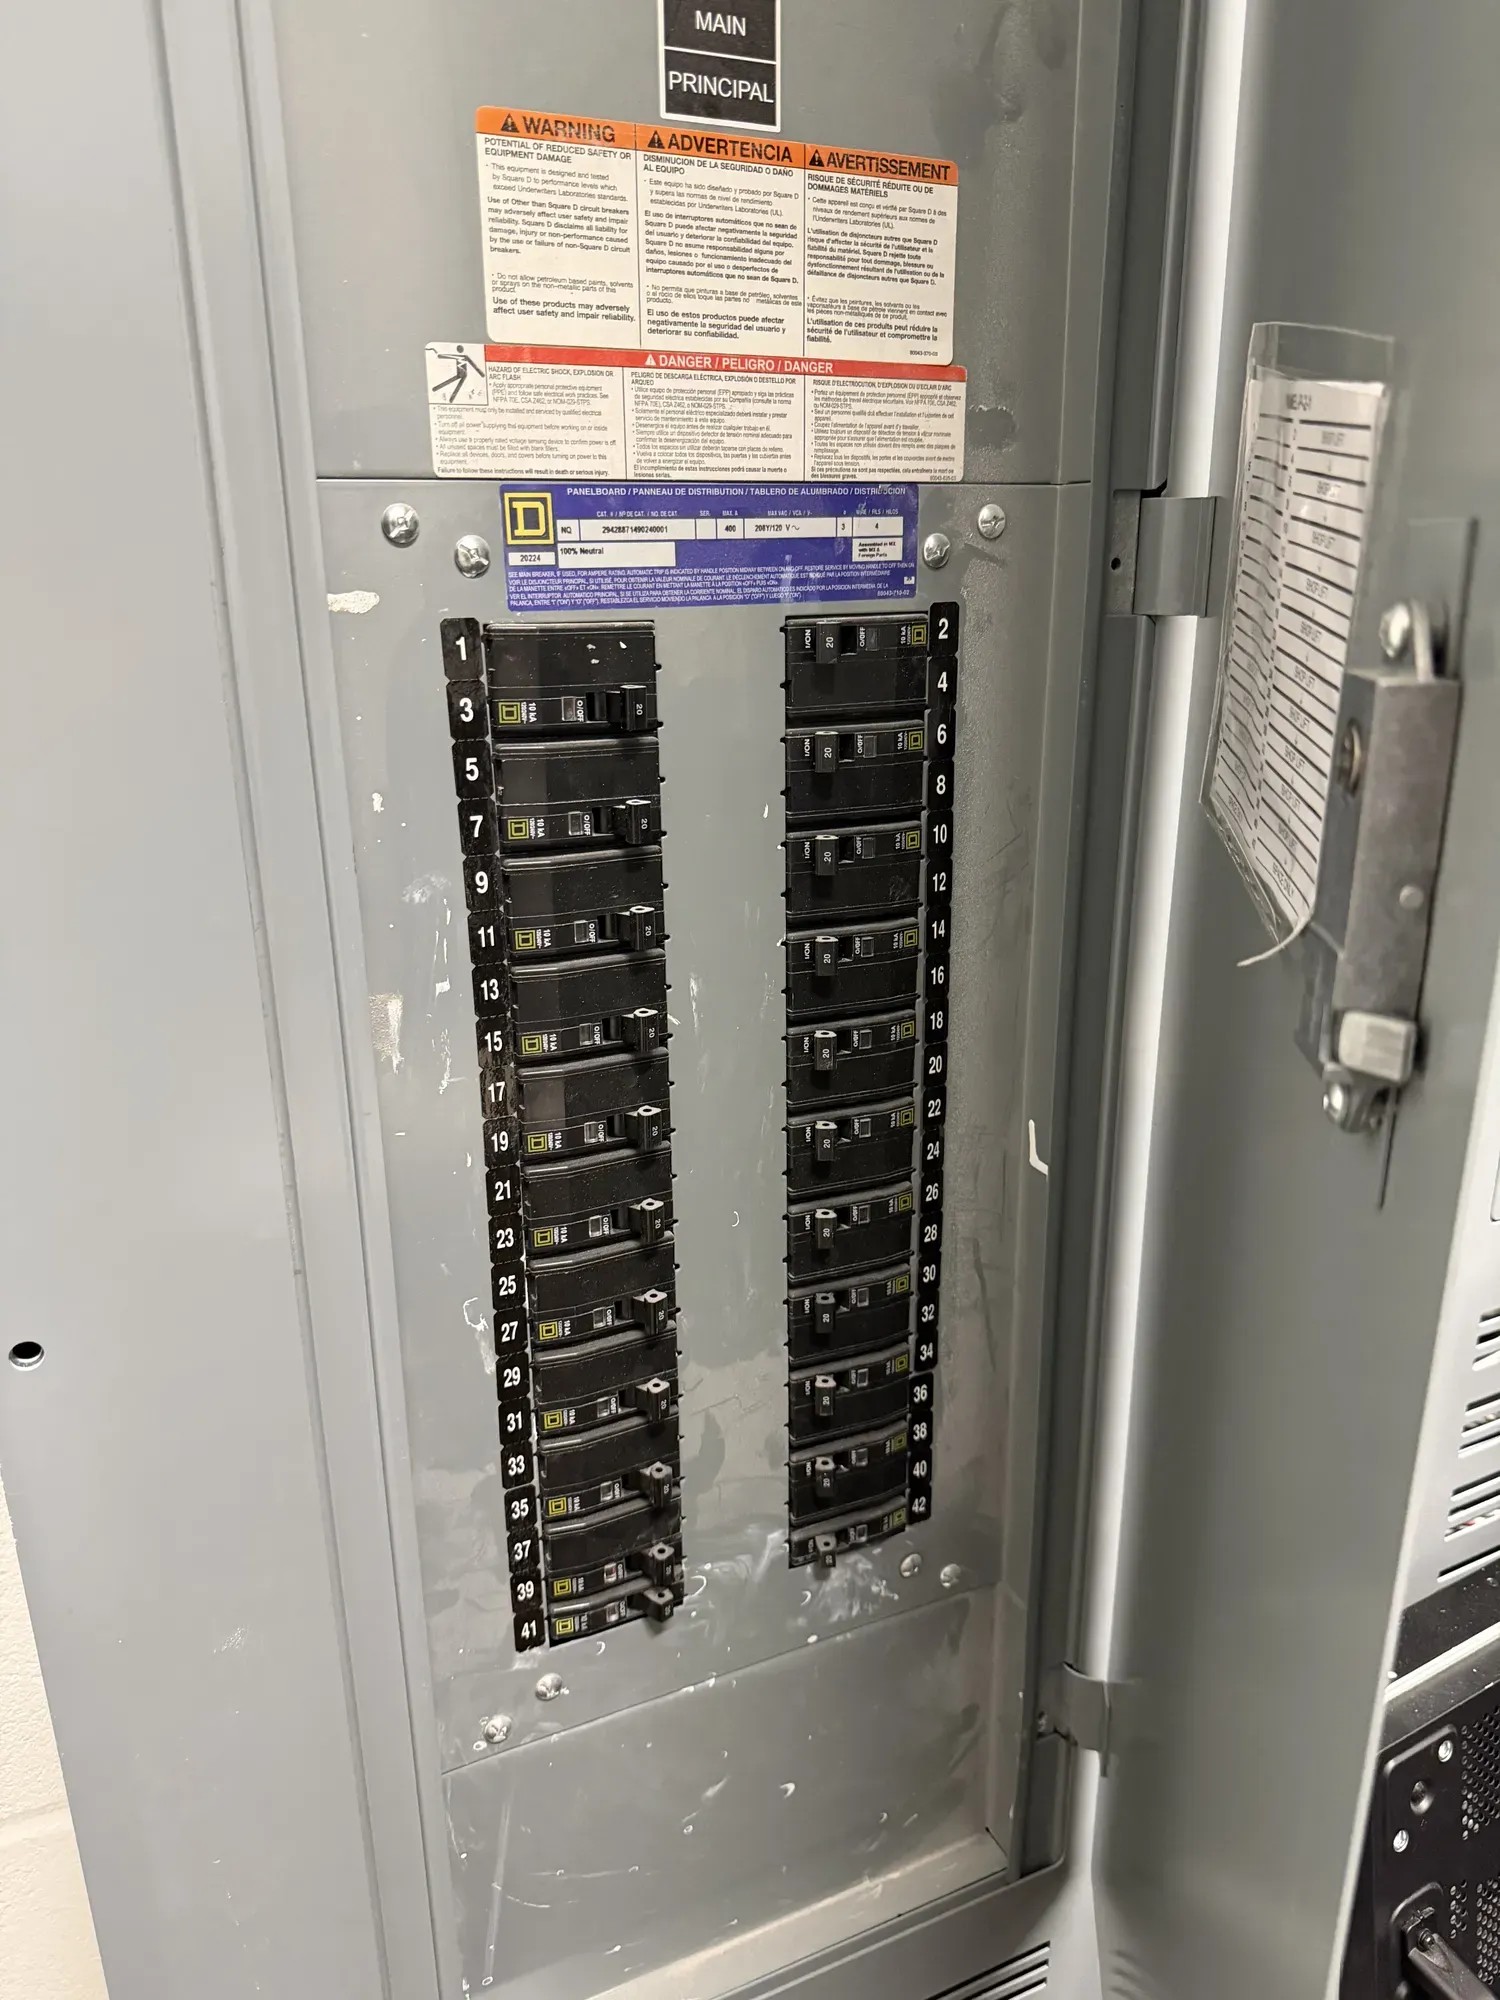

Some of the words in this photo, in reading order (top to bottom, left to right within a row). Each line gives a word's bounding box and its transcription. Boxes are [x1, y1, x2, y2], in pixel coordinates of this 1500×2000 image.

[695, 10, 746, 36] MAIN
[668, 71, 774, 103] PRINCIPAL
[522, 116, 615, 142] WARNING
[484, 137, 530, 150] POTENTIAL
[533, 142, 543, 150] OF
[546, 144, 586, 155] REDUCED
[587, 148, 617, 159] SAFETY
[620, 151, 631, 160] OR
[485, 148, 534, 159] EQUIPMENT
[537, 153, 572, 163] DAMAGE
[668, 134, 793, 163] ADVERTENCIA
[644, 154, 695, 167] DISMINUCION
[709, 161, 719, 169] LA
[720, 163, 763, 174] SEGURIDAD
[773, 167, 793, 177] DAÑO
[644, 164, 653, 172] AL
[656, 166, 685, 176] EQUIPO
[827, 152, 950, 181] AVERTISSEMENT
[808, 174, 833, 183] RISQUE
[847, 177, 880, 188] SÉCURITÉ
[882, 181, 911, 192] RÉDUITE
[913, 185, 922, 193] OU
[924, 186, 933, 194] DE
[808, 183, 848, 194] DOMMAGES
[851, 186, 888, 198] MATÉRIELS
[493, 306, 515, 315] affect
[536, 309, 558, 318] safety
[577, 312, 599, 320] impair
[602, 313, 635, 322] reliability.
[520, 299, 540, 307] these
[543, 301, 575, 310] products
[578, 303, 593, 311] may
[596, 304, 630, 313] adversely
[647, 318, 698, 328] negativamente
[709, 322, 741, 332] seguridad
[744, 323, 754, 331] del
[756, 325, 780, 333] usuario
[671, 310, 679, 318] de
[703, 313, 737, 323] productos
[739, 315, 759, 324] puede
[761, 316, 784, 324] afectar
[807, 318, 843, 327] L'utilisation
[867, 322, 892, 332] produits
[895, 324, 908, 333] peut
[910, 323, 930, 332] réduire
[647, 328, 681, 336] deteriorar
[694, 330, 739, 339] confiabilidad.
[807, 326, 832, 335] sécurité
[888, 332, 930, 342] compromettre
[807, 335, 832, 343] fiabilité.
[659, 354, 711, 368] DANGER
[722, 358, 774, 371] PELIGRO
[785, 361, 833, 374] DANGER
[725, 524, 736, 532] 400
[754, 524, 783, 532] 208Y/120
[841, 523, 845, 531] 3
[580, 547, 604, 555] Neutral
[938, 617, 949, 640] 2
[455, 636, 467, 661] 1
[826, 636, 834, 648] 20
[937, 671, 948, 693] 4
[458, 697, 474, 723] 3
[529, 702, 536, 711] 10
[636, 703, 643, 715] 20
[937, 723, 947, 745] 6
[824, 747, 832, 759] 20
[465, 757, 480, 782] 5
[936, 774, 946, 795] 8
[469, 814, 484, 838] 7
[641, 818, 648, 830] 20
[932, 823, 948, 844] 10
[824, 851, 831, 863] 20
[474, 870, 489, 894] 9
[932, 871, 947, 892] 12
[477, 925, 495, 948] 11
[645, 925, 651, 937] 20
[931, 919, 945, 939] 14
[824, 953, 831, 964] 20
[930, 965, 945, 985] 16
[480, 978, 500, 1001] 13
[930, 1010, 944, 1030] 18
[484, 1030, 503, 1053] 15
[649, 1028, 654, 1039] 20
[822, 1049, 830, 1059] 20
[928, 1055, 943, 1075] 20
[487, 1080, 506, 1103] 17
[927, 1098, 941, 1118] 22
[652, 1125, 658, 1137] 20
[490, 1130, 509, 1153] 19
[824, 1139, 831, 1149] 20
[926, 1141, 940, 1160] 24
[494, 1179, 511, 1202] 21
[925, 1182, 939, 1202] 26
[655, 1218, 660, 1229] 20
[923, 1224, 938, 1243] 28
[496, 1227, 515, 1250] 23
[922, 1264, 936, 1283] 30
[498, 1274, 517, 1297] 25
[921, 1303, 935, 1323] 32
[500, 1320, 519, 1343] 27
[919, 1342, 933, 1361] 34
[503, 1366, 521, 1388] 29
[913, 1384, 928, 1403] 36
[506, 1410, 523, 1433] 31
[913, 1422, 927, 1441] 38
[507, 1454, 526, 1477] 33
[912, 1460, 927, 1477] 40
[510, 1497, 529, 1520] 35
[912, 1496, 926, 1513] 42
[513, 1539, 532, 1561] 37
[516, 1580, 535, 1601] 39
[521, 1619, 537, 1639] 41
